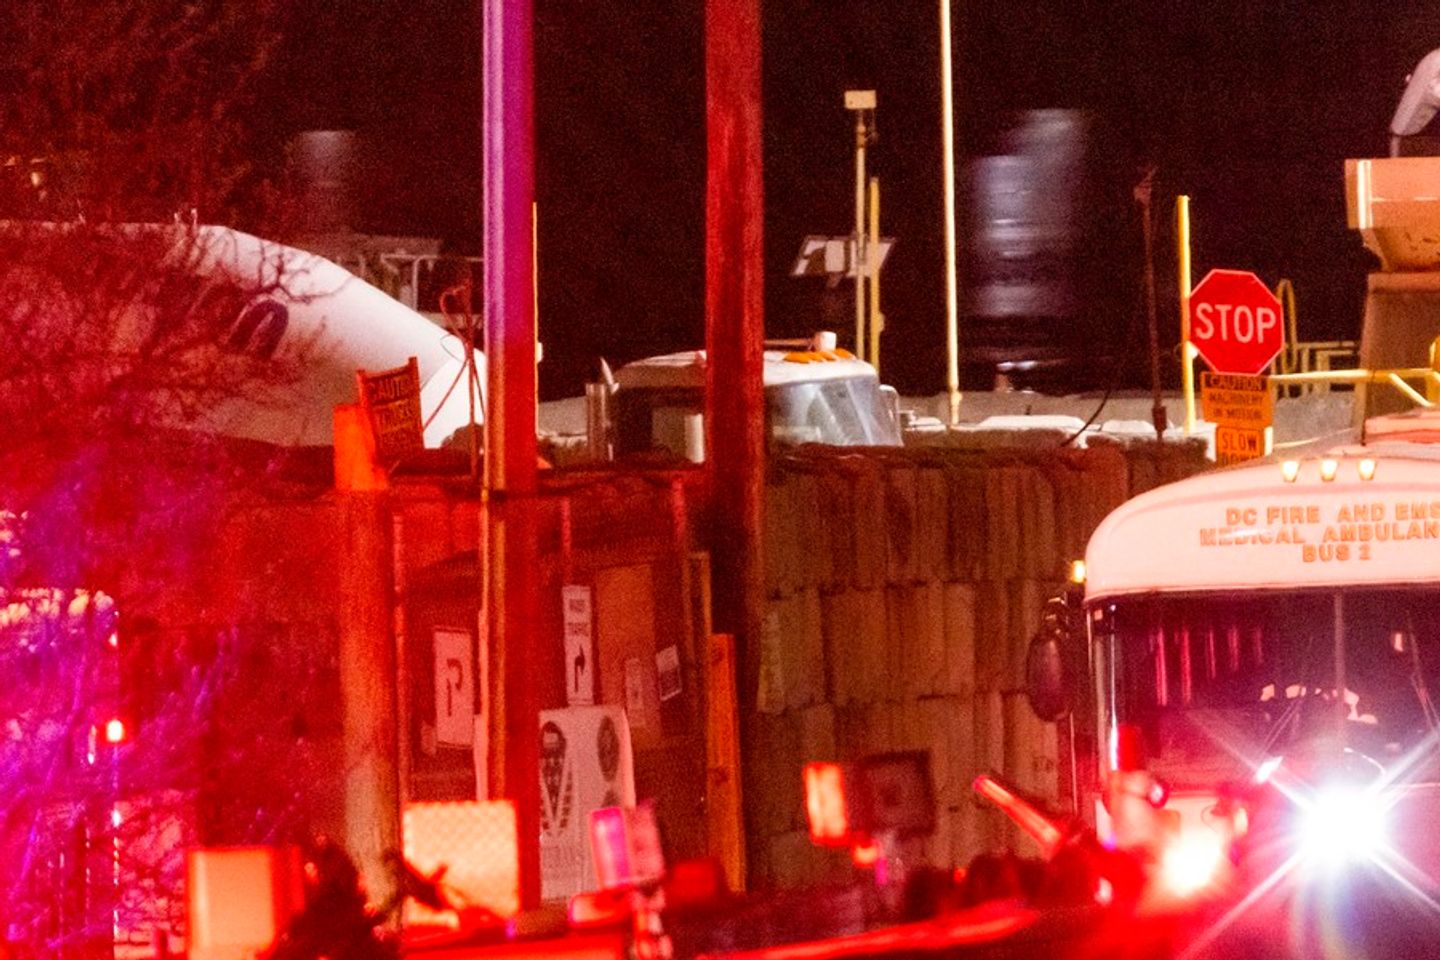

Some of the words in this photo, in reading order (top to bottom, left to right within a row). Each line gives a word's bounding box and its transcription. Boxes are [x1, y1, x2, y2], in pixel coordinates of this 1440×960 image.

[1195, 303, 1276, 344] STOP
[1222, 431, 1257, 451] SLOW
[1226, 507, 1258, 526] DC
[1267, 506, 1320, 525] FIRE
[1337, 503, 1386, 522] AND
[1200, 527, 1306, 546] MEDICAL
[1302, 544, 1350, 563] BUS
